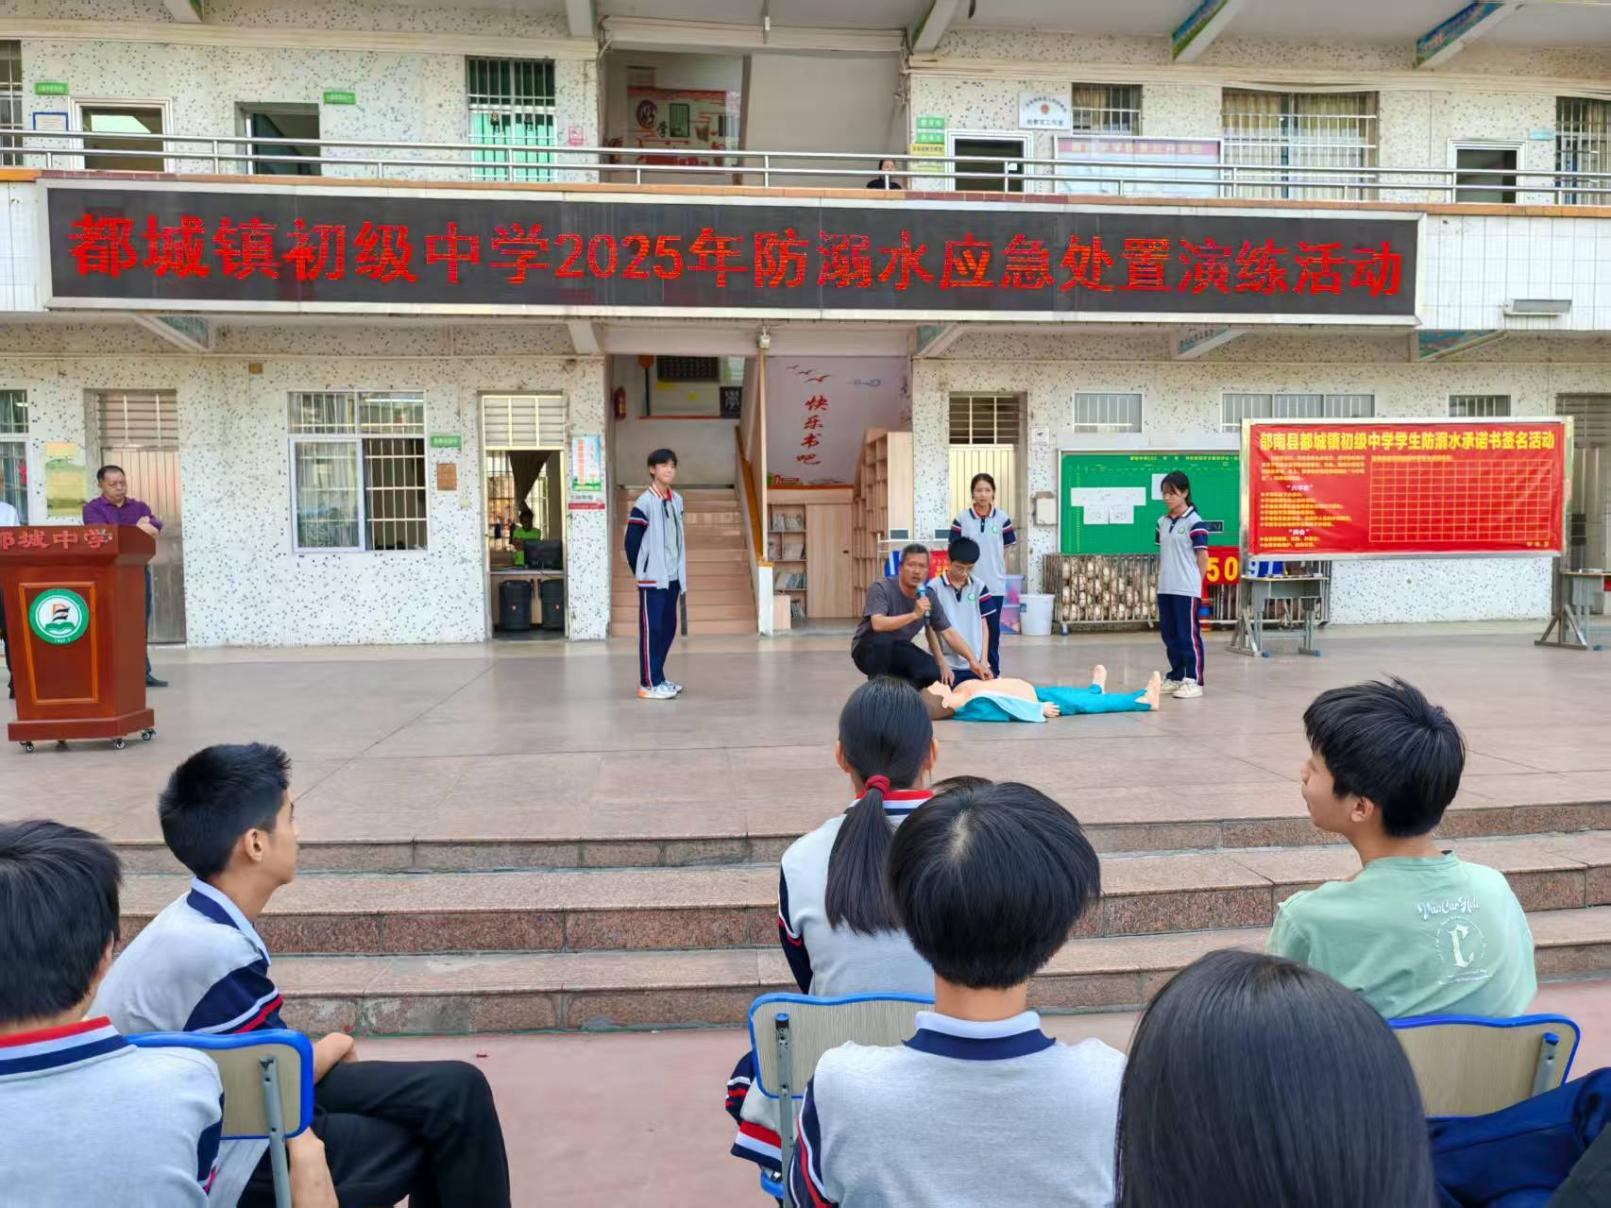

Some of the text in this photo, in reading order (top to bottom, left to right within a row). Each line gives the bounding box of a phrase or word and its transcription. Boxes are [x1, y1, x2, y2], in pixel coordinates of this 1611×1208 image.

[68, 213, 1402, 298] 都城镇初级中学2025年防溺水应急处置演练活动
[796, 394, 828, 465] 快乐书吧
